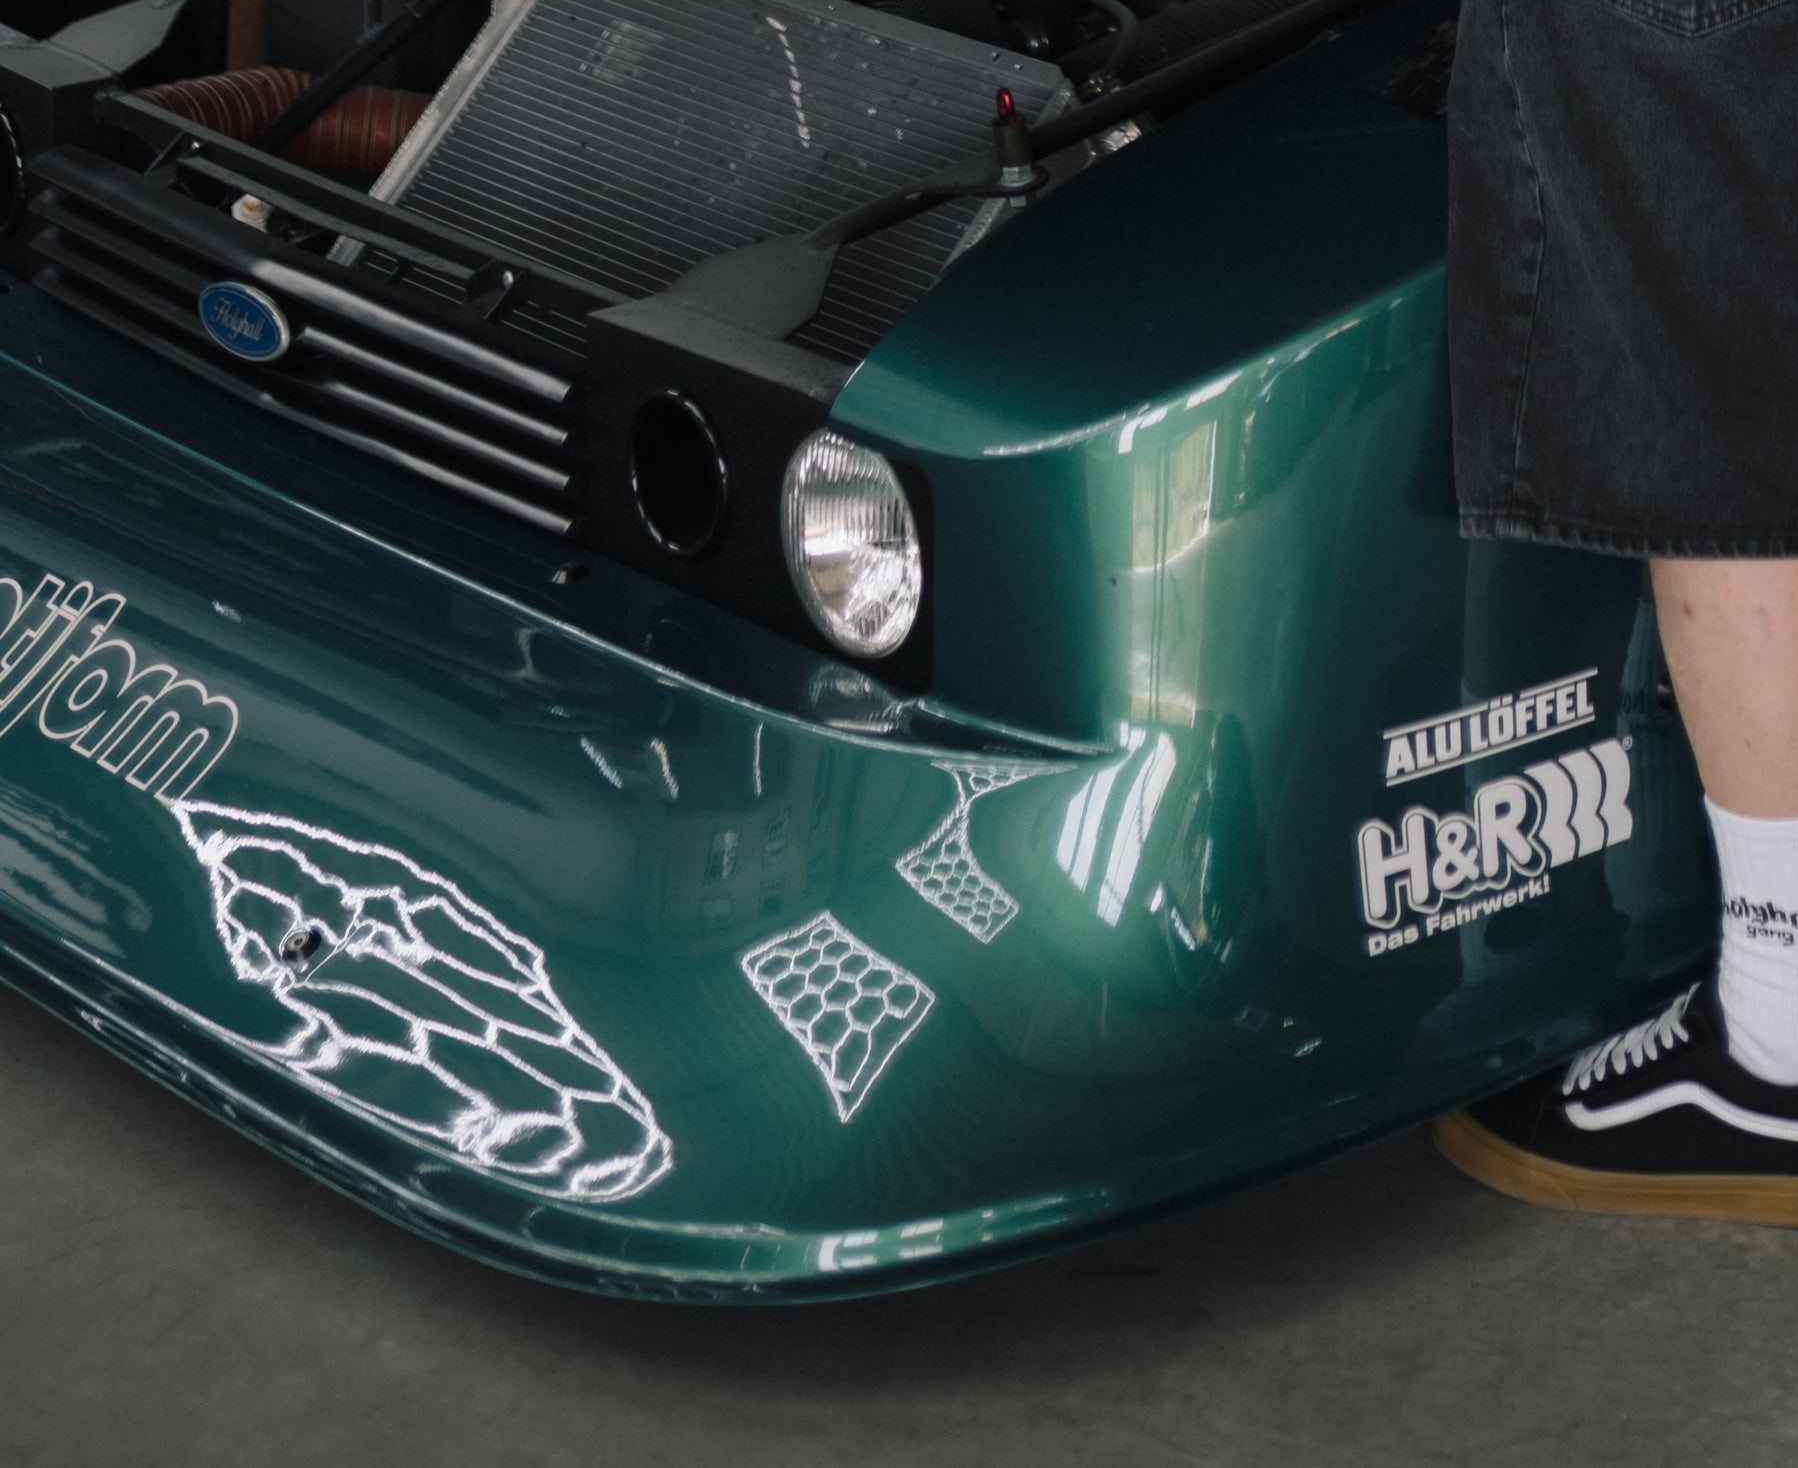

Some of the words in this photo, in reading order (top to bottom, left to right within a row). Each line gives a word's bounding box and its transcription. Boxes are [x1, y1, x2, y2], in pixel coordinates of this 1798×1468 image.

[0, 573, 239, 807] tiform
[1386, 717, 1462, 779] ALU
[1468, 678, 1595, 755] LÖFFEL
[1357, 774, 1547, 930] H&R
[1368, 922, 1420, 958] Das
[1425, 874, 1551, 937] Fahrwerk!
